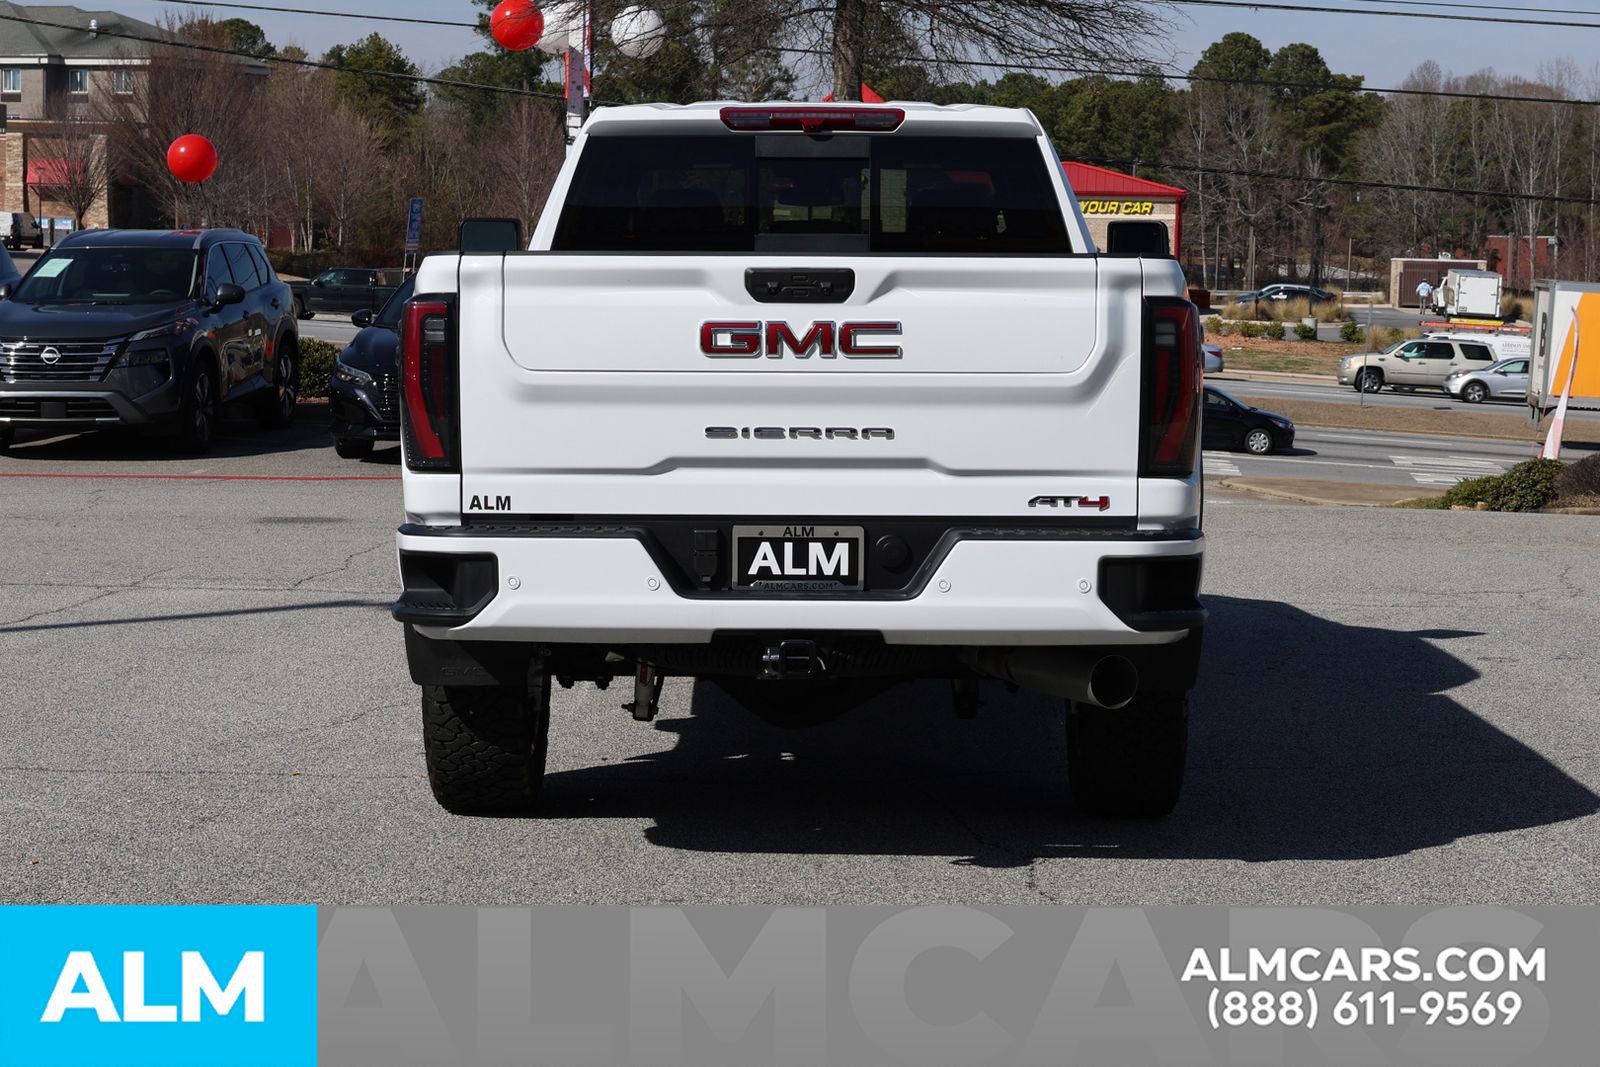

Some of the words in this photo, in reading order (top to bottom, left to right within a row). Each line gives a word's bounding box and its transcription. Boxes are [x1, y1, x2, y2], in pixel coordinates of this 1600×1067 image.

[1080, 200, 1119, 214] YOUR
[1122, 201, 1154, 214] CAR
[700, 320, 903, 359] GMC
[705, 426, 895, 440] SIERRA
[469, 494, 511, 511] ALM
[1028, 495, 1110, 511] AT4
[783, 526, 814, 537] ALM
[748, 541, 849, 576] ALM
